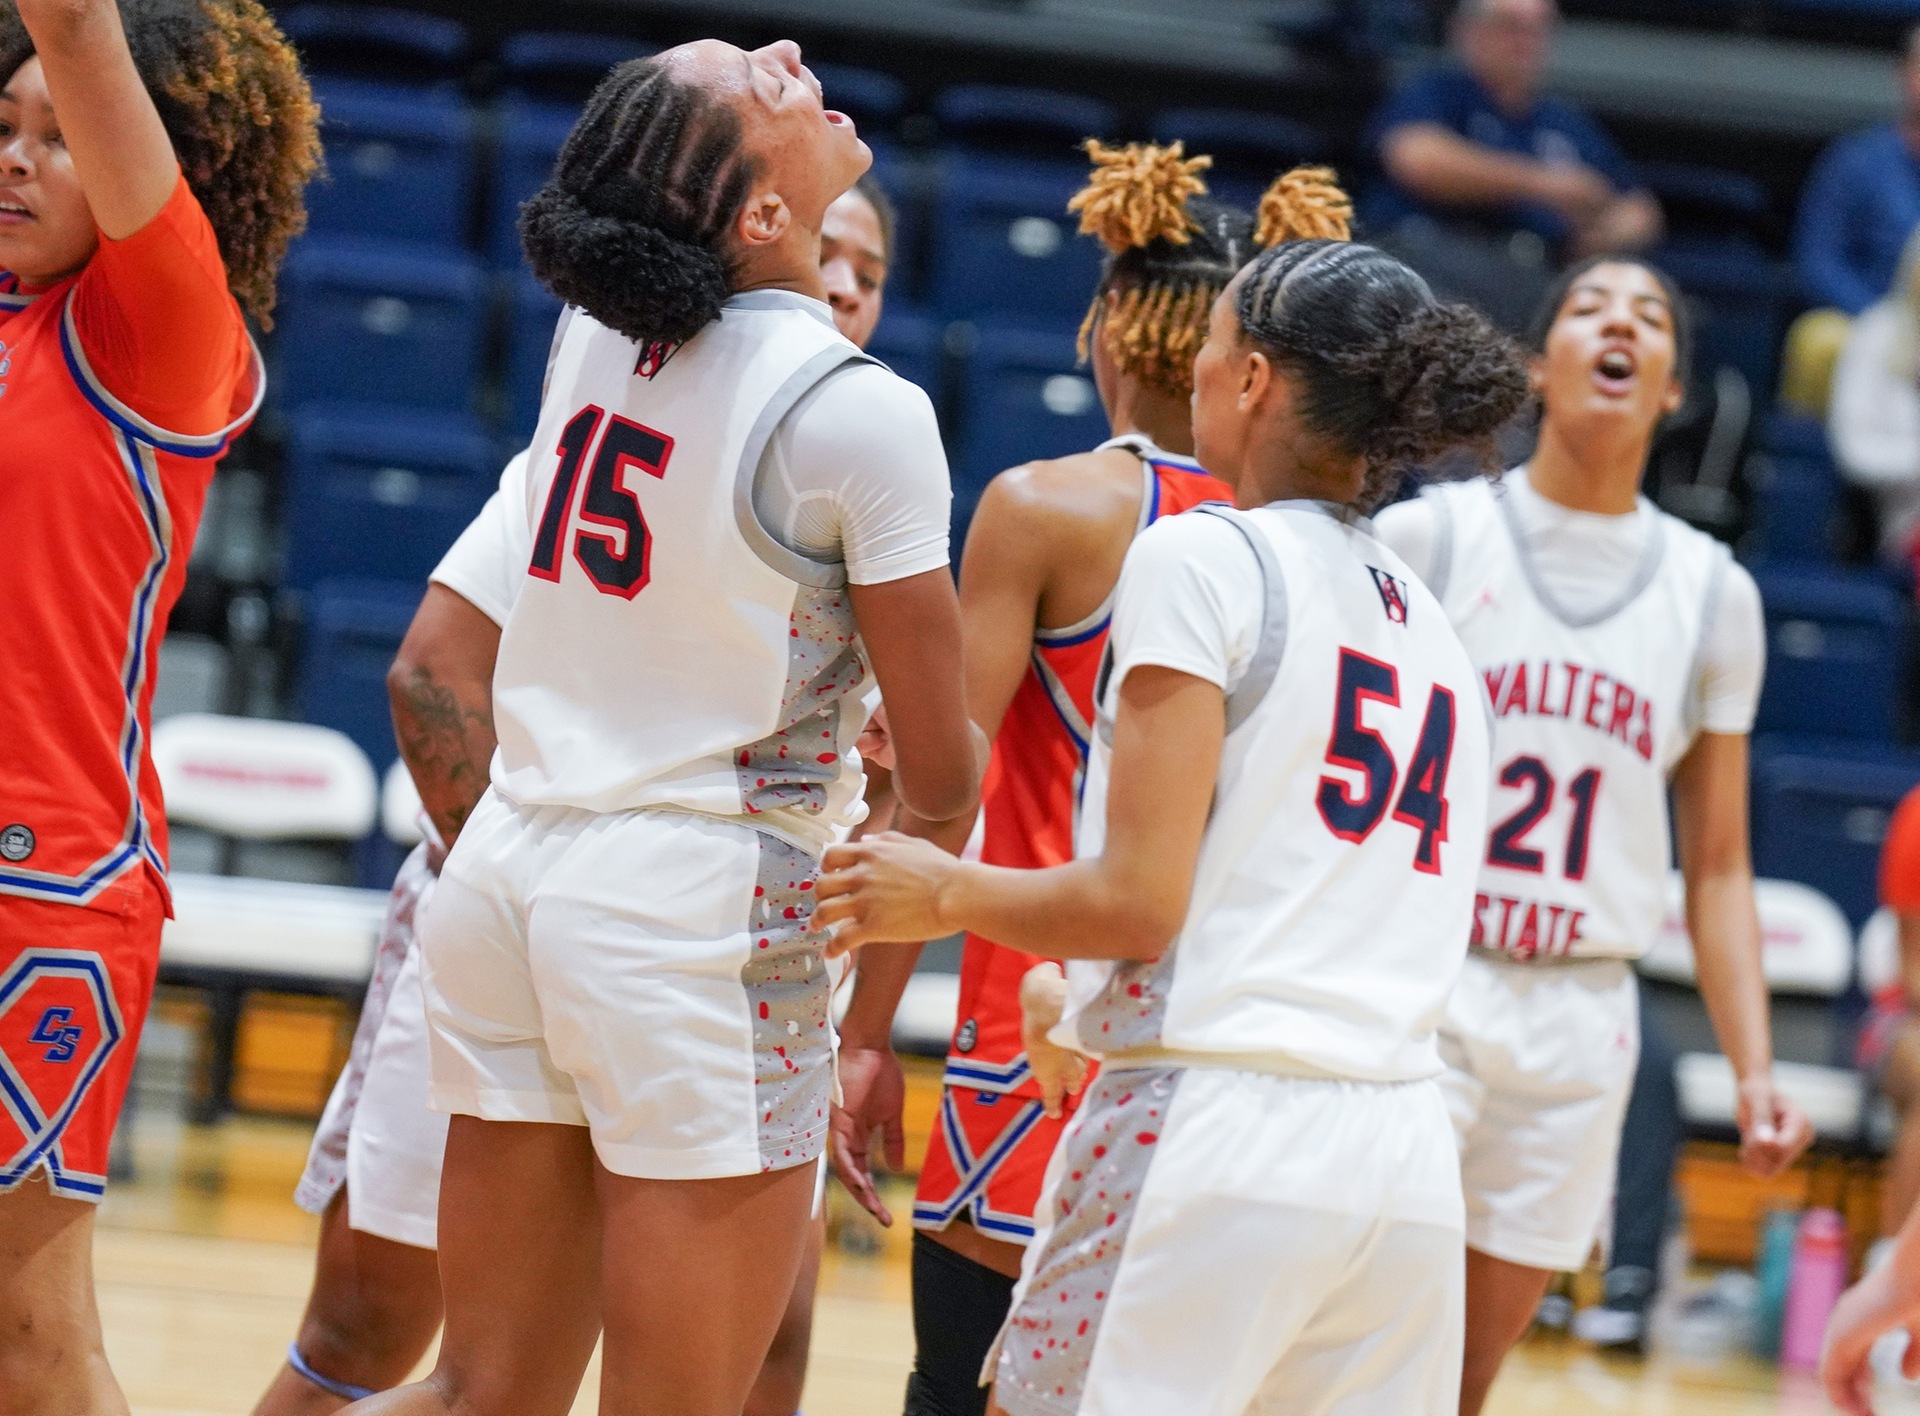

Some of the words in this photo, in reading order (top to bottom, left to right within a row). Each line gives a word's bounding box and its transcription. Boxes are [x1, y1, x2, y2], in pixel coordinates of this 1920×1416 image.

[528, 403, 675, 602] 15
[1315, 645, 1456, 876] 54
[1486, 756, 1602, 881] 21
[28, 1006, 84, 1063] CS
